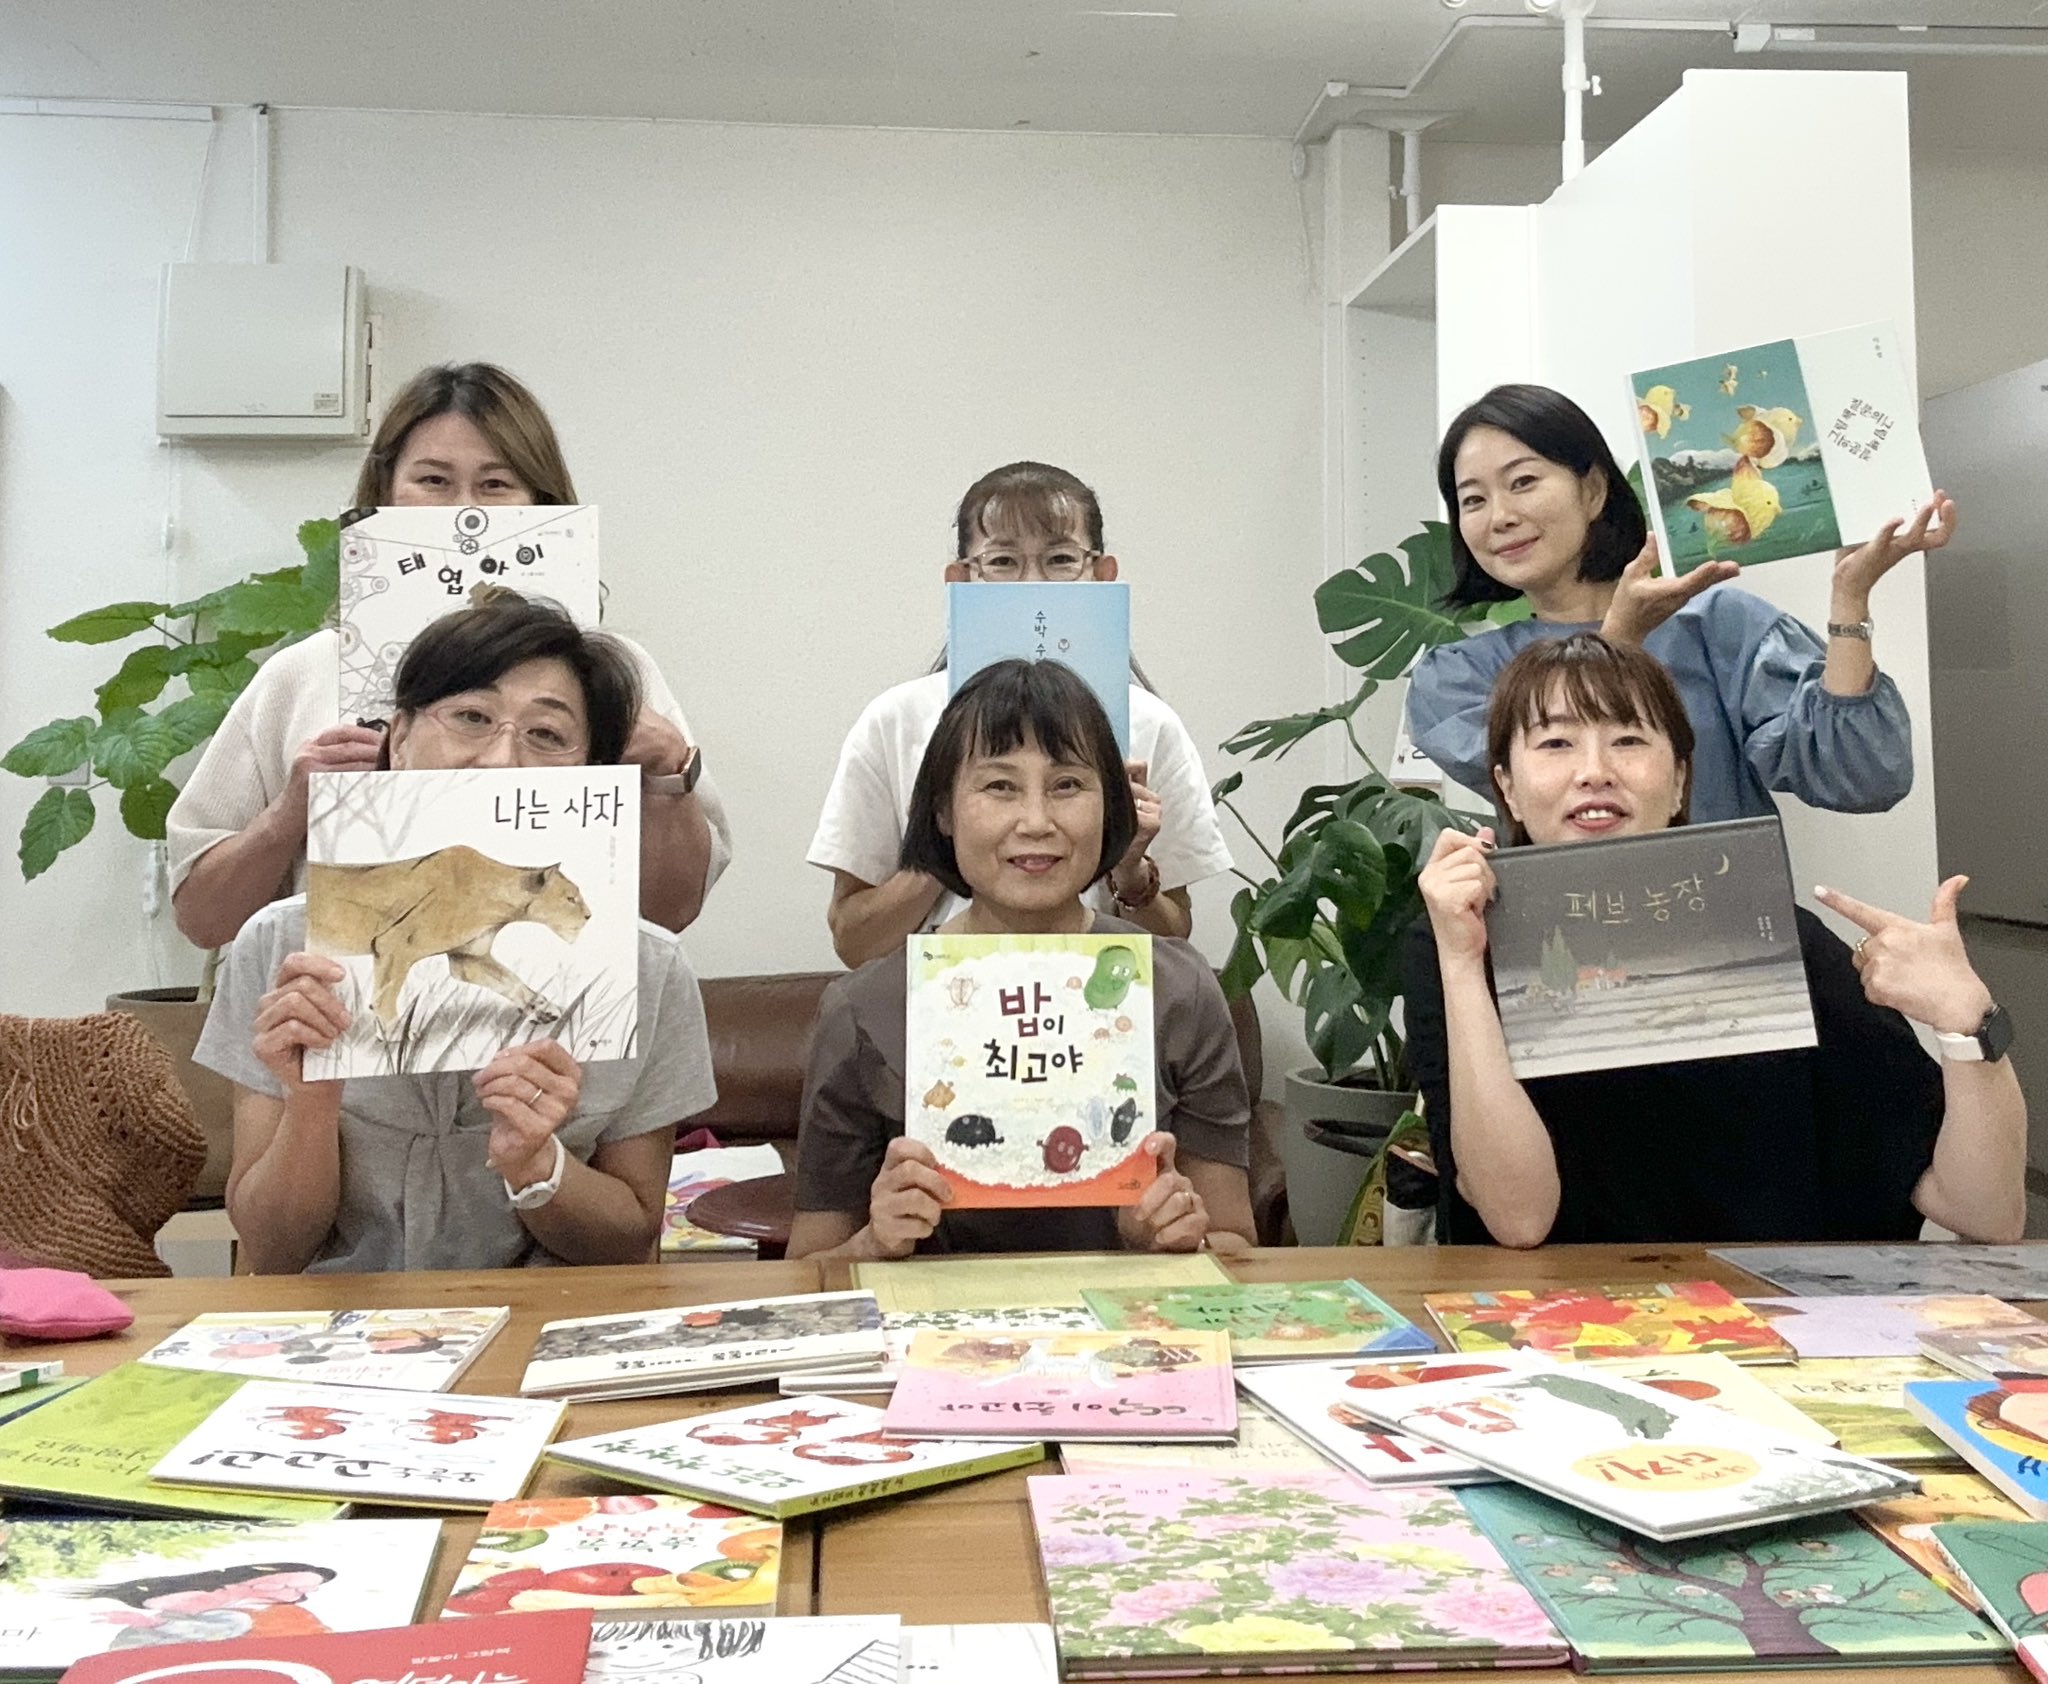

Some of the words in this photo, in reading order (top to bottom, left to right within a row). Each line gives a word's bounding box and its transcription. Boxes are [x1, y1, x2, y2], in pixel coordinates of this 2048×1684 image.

[494, 787, 549, 829] 나는
[564, 785, 624, 828] 사자
[1644, 873, 1706, 923] 농장
[998, 981, 1064, 1037] 밥이
[983, 1038, 1084, 1084] 최고야
[938, 1401, 1056, 1416] 최고야
[188, 1450, 391, 1479] 고고고!
[390, 1467, 485, 1483] 오늘도
[711, 1464, 805, 1489] 오늘도
[464, 1646, 512, 1659] 그림책
